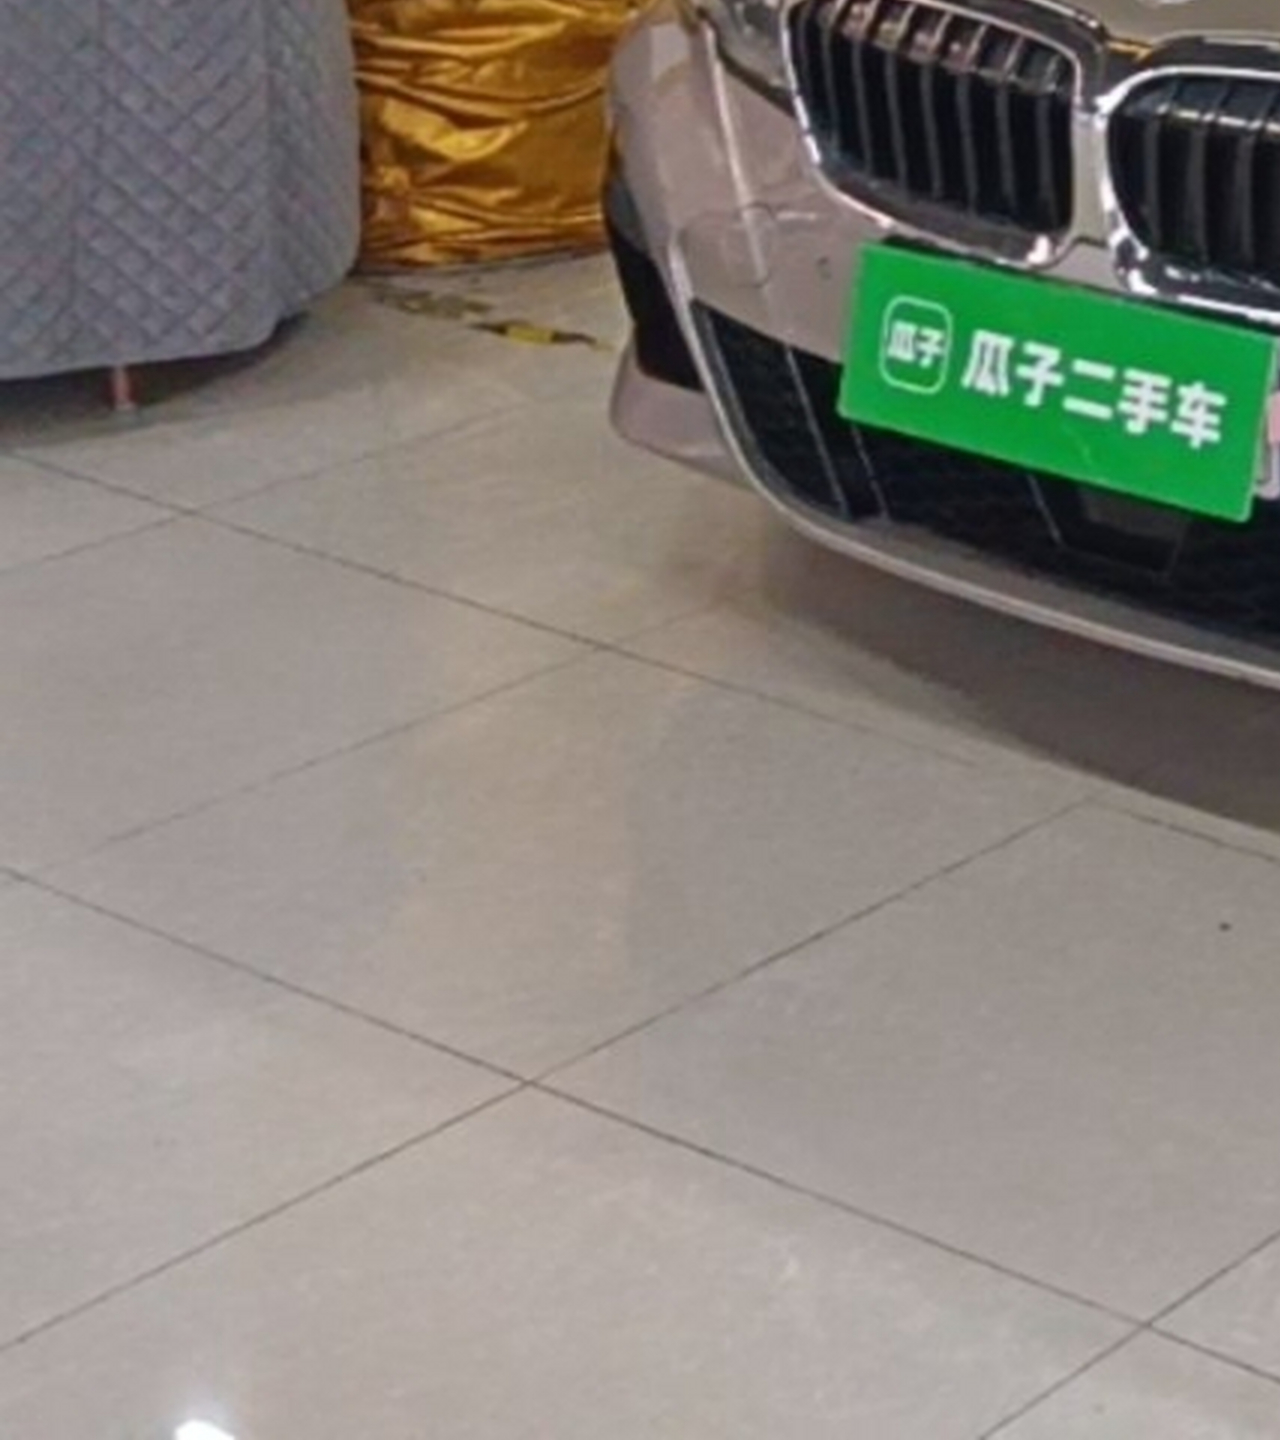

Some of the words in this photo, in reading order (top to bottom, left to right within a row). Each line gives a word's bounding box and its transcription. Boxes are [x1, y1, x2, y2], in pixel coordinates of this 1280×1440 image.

[886, 320, 947, 369] 瓜子
[961, 329, 1227, 449] 瓜子二手车
